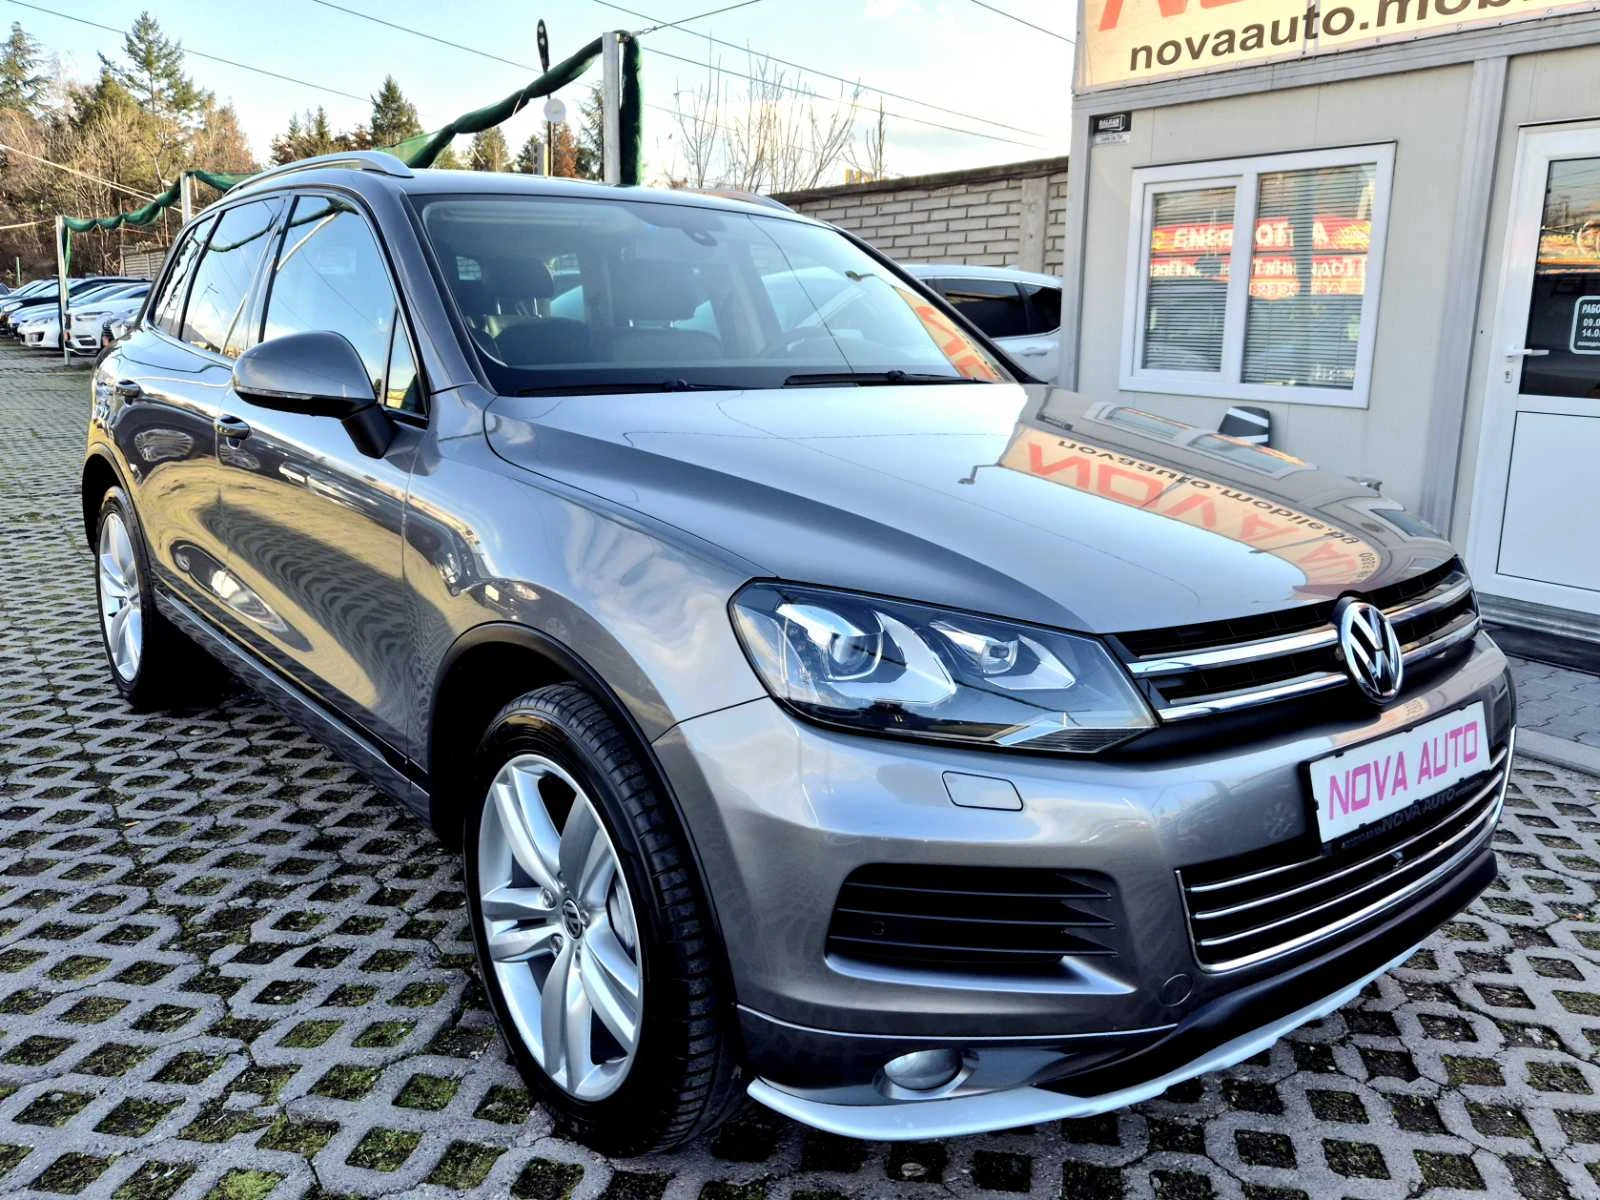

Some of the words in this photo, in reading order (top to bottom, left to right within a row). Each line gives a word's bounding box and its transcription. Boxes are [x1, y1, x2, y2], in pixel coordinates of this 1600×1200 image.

[1130, 0, 1508, 71] novaauto.mo
[1329, 751, 1408, 821] NOVA
[1417, 720, 1478, 785] AUTO
[1382, 804, 1422, 831] NOVA
[1422, 788, 1457, 815] AUTO
